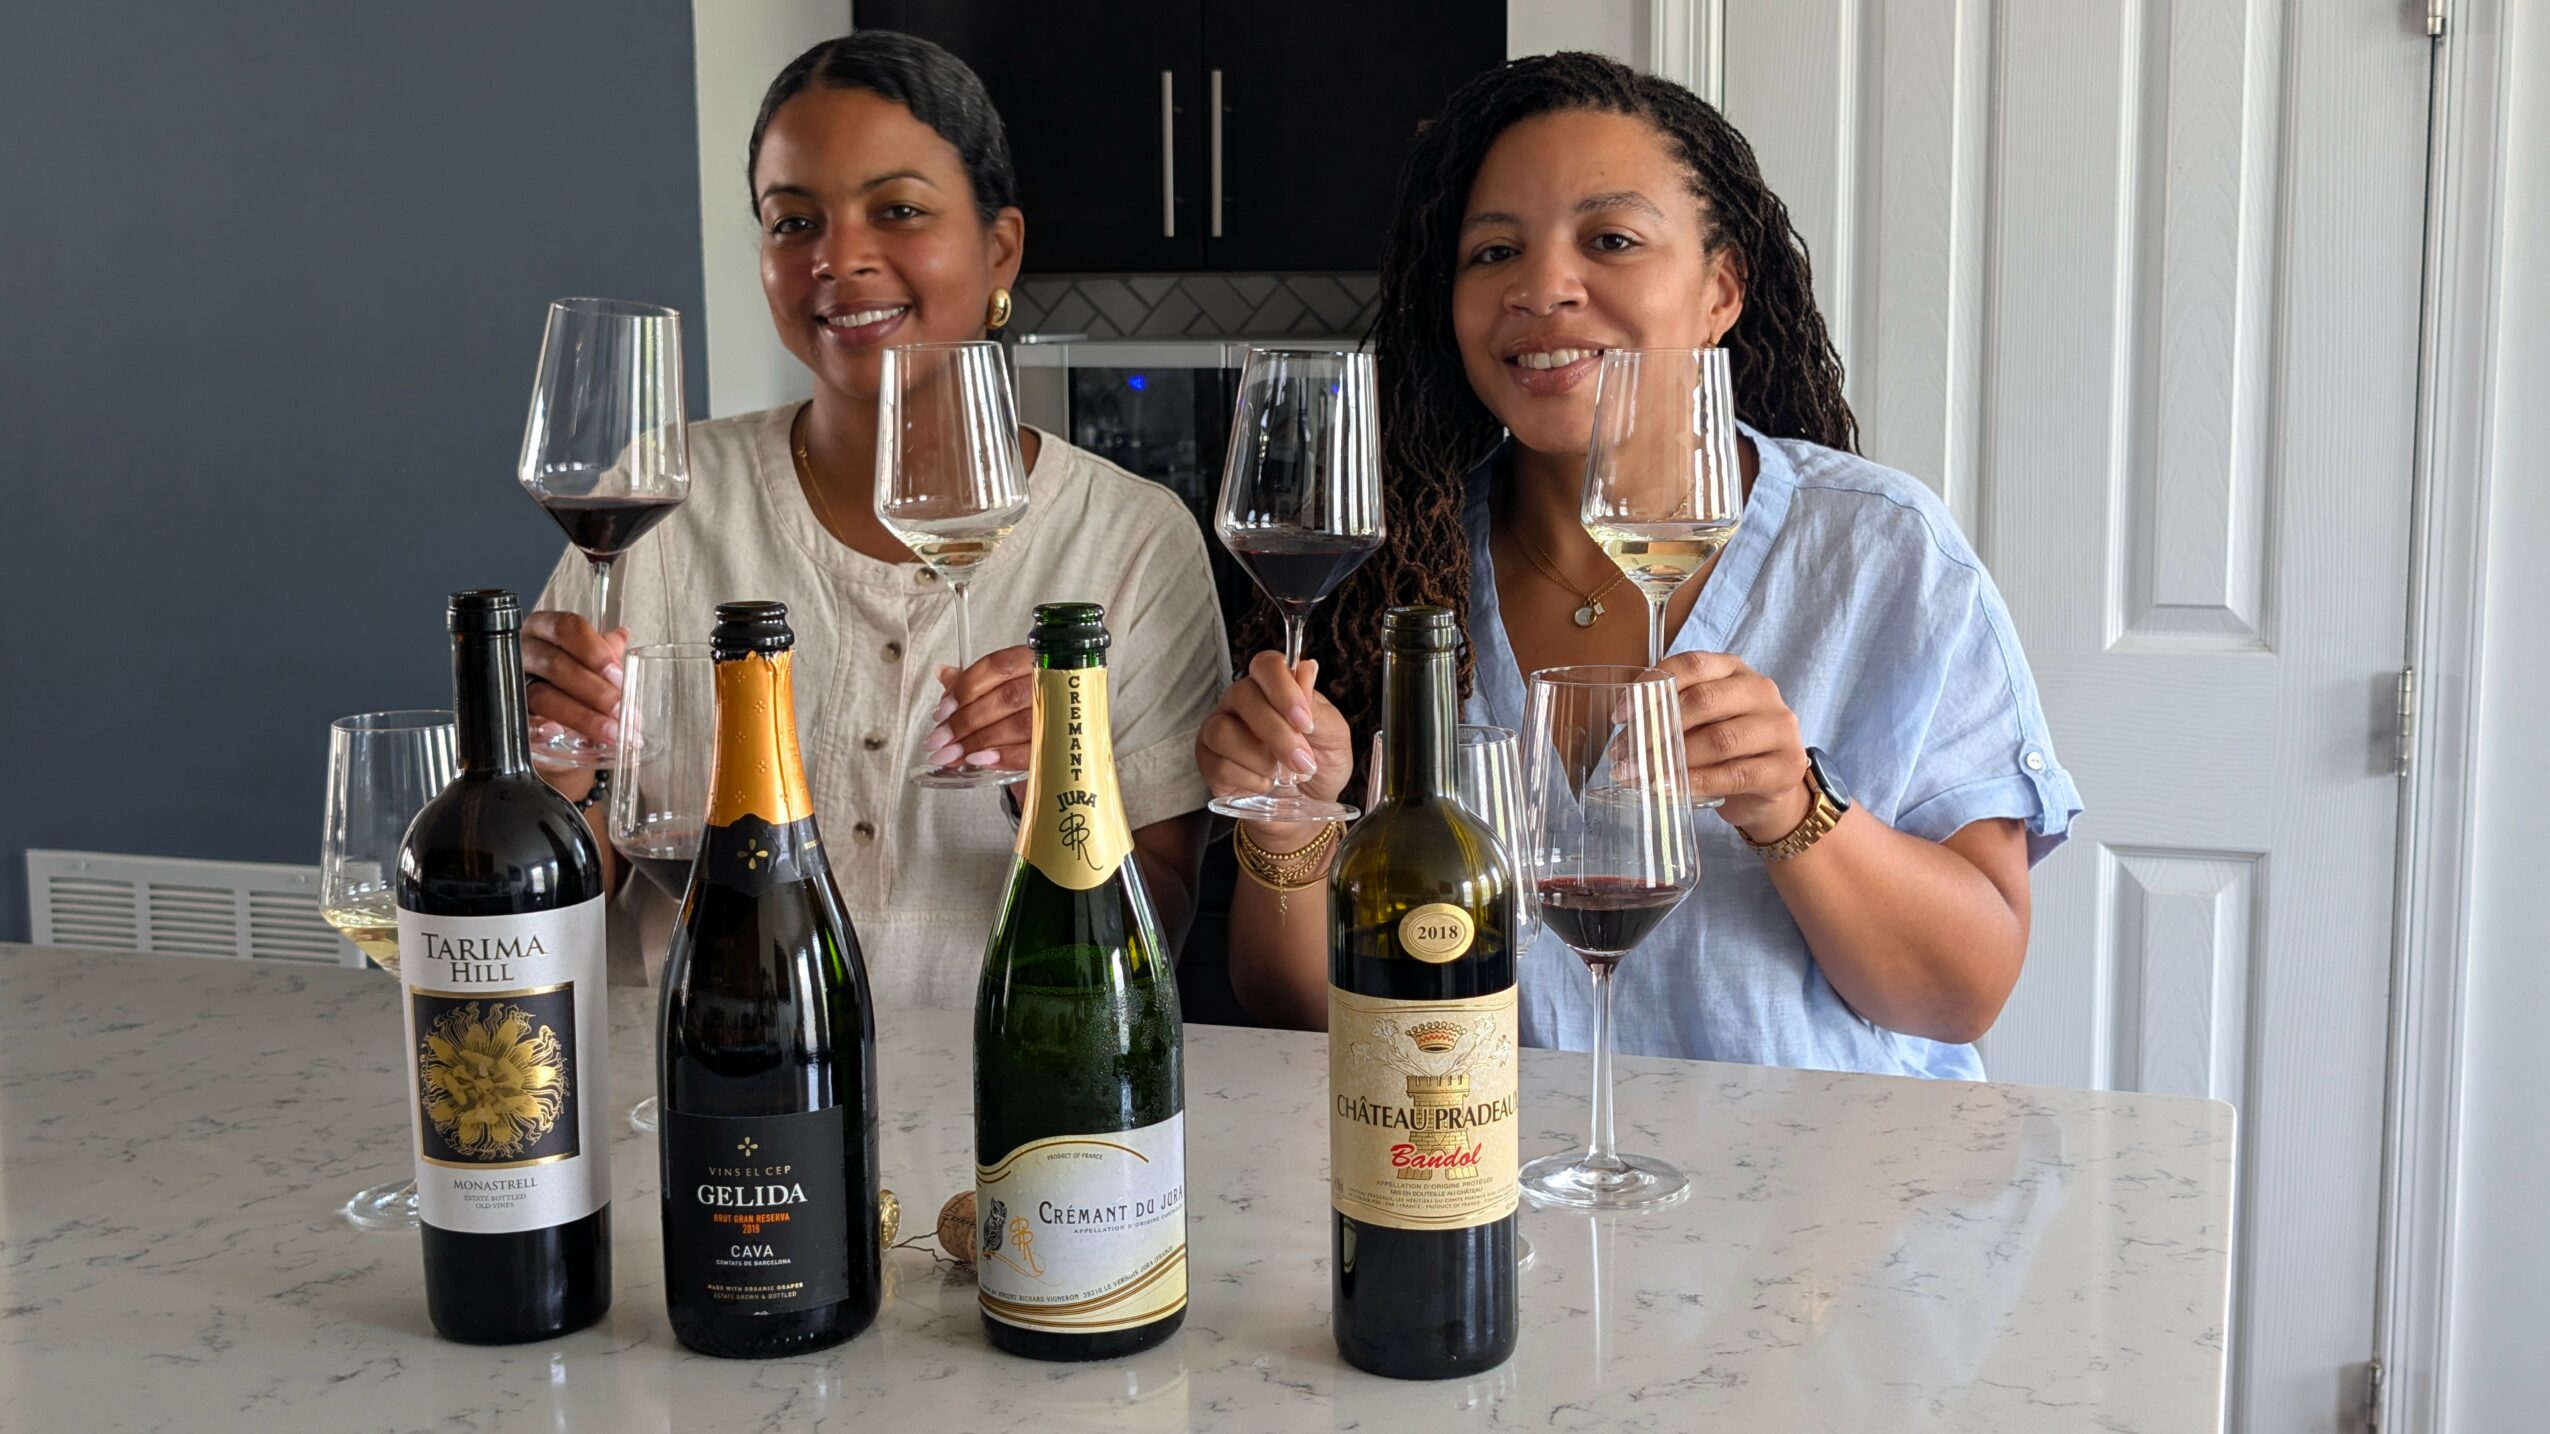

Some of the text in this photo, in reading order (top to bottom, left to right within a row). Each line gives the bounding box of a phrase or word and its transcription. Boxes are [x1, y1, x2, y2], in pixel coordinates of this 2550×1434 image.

[1067, 674, 1083, 782] CREMANT
[1056, 789, 1098, 813] JURA
[1417, 925, 1458, 940] 2018
[420, 931, 549, 961] TARIMA
[450, 961, 514, 983] HILL
[1337, 1094, 1428, 1131] CHÂTEAU
[1047, 1152, 1104, 1160] PRODUCT OF FRANCE
[1390, 1142, 1483, 1169] Bandol
[709, 1165, 792, 1177] VINS EL CEP
[453, 1177, 538, 1191] MONASTRELL
[1376, 1179, 1422, 1190] APPELLATION
[1424, 1182, 1461, 1190] D'ORIGINE
[464, 1193, 527, 1202] ESTATE BOTTLED
[697, 1182, 808, 1207] GELIDA
[1039, 1184, 1184, 1225] CRÉMANT DU JURA
[713, 1212, 791, 1223] BRUT GRAN RESERVA
[742, 1224, 760, 1234] 2019
[1073, 1225, 1125, 1234] APPELLATION
[1127, 1216, 1160, 1229] D'ORIGINE
[731, 1244, 774, 1258] CAVA
[754, 1258, 792, 1267] BARCELONA
[776, 1281, 804, 1291] GRAPES
[1019, 1294, 1045, 1303] RICHARD
[1046, 1293, 1080, 1303] VIGNERON
[1083, 1287, 1103, 1299] 39210
[1103, 1283, 1112, 1291] LE
[768, 1291, 797, 1300] BOTTLED
